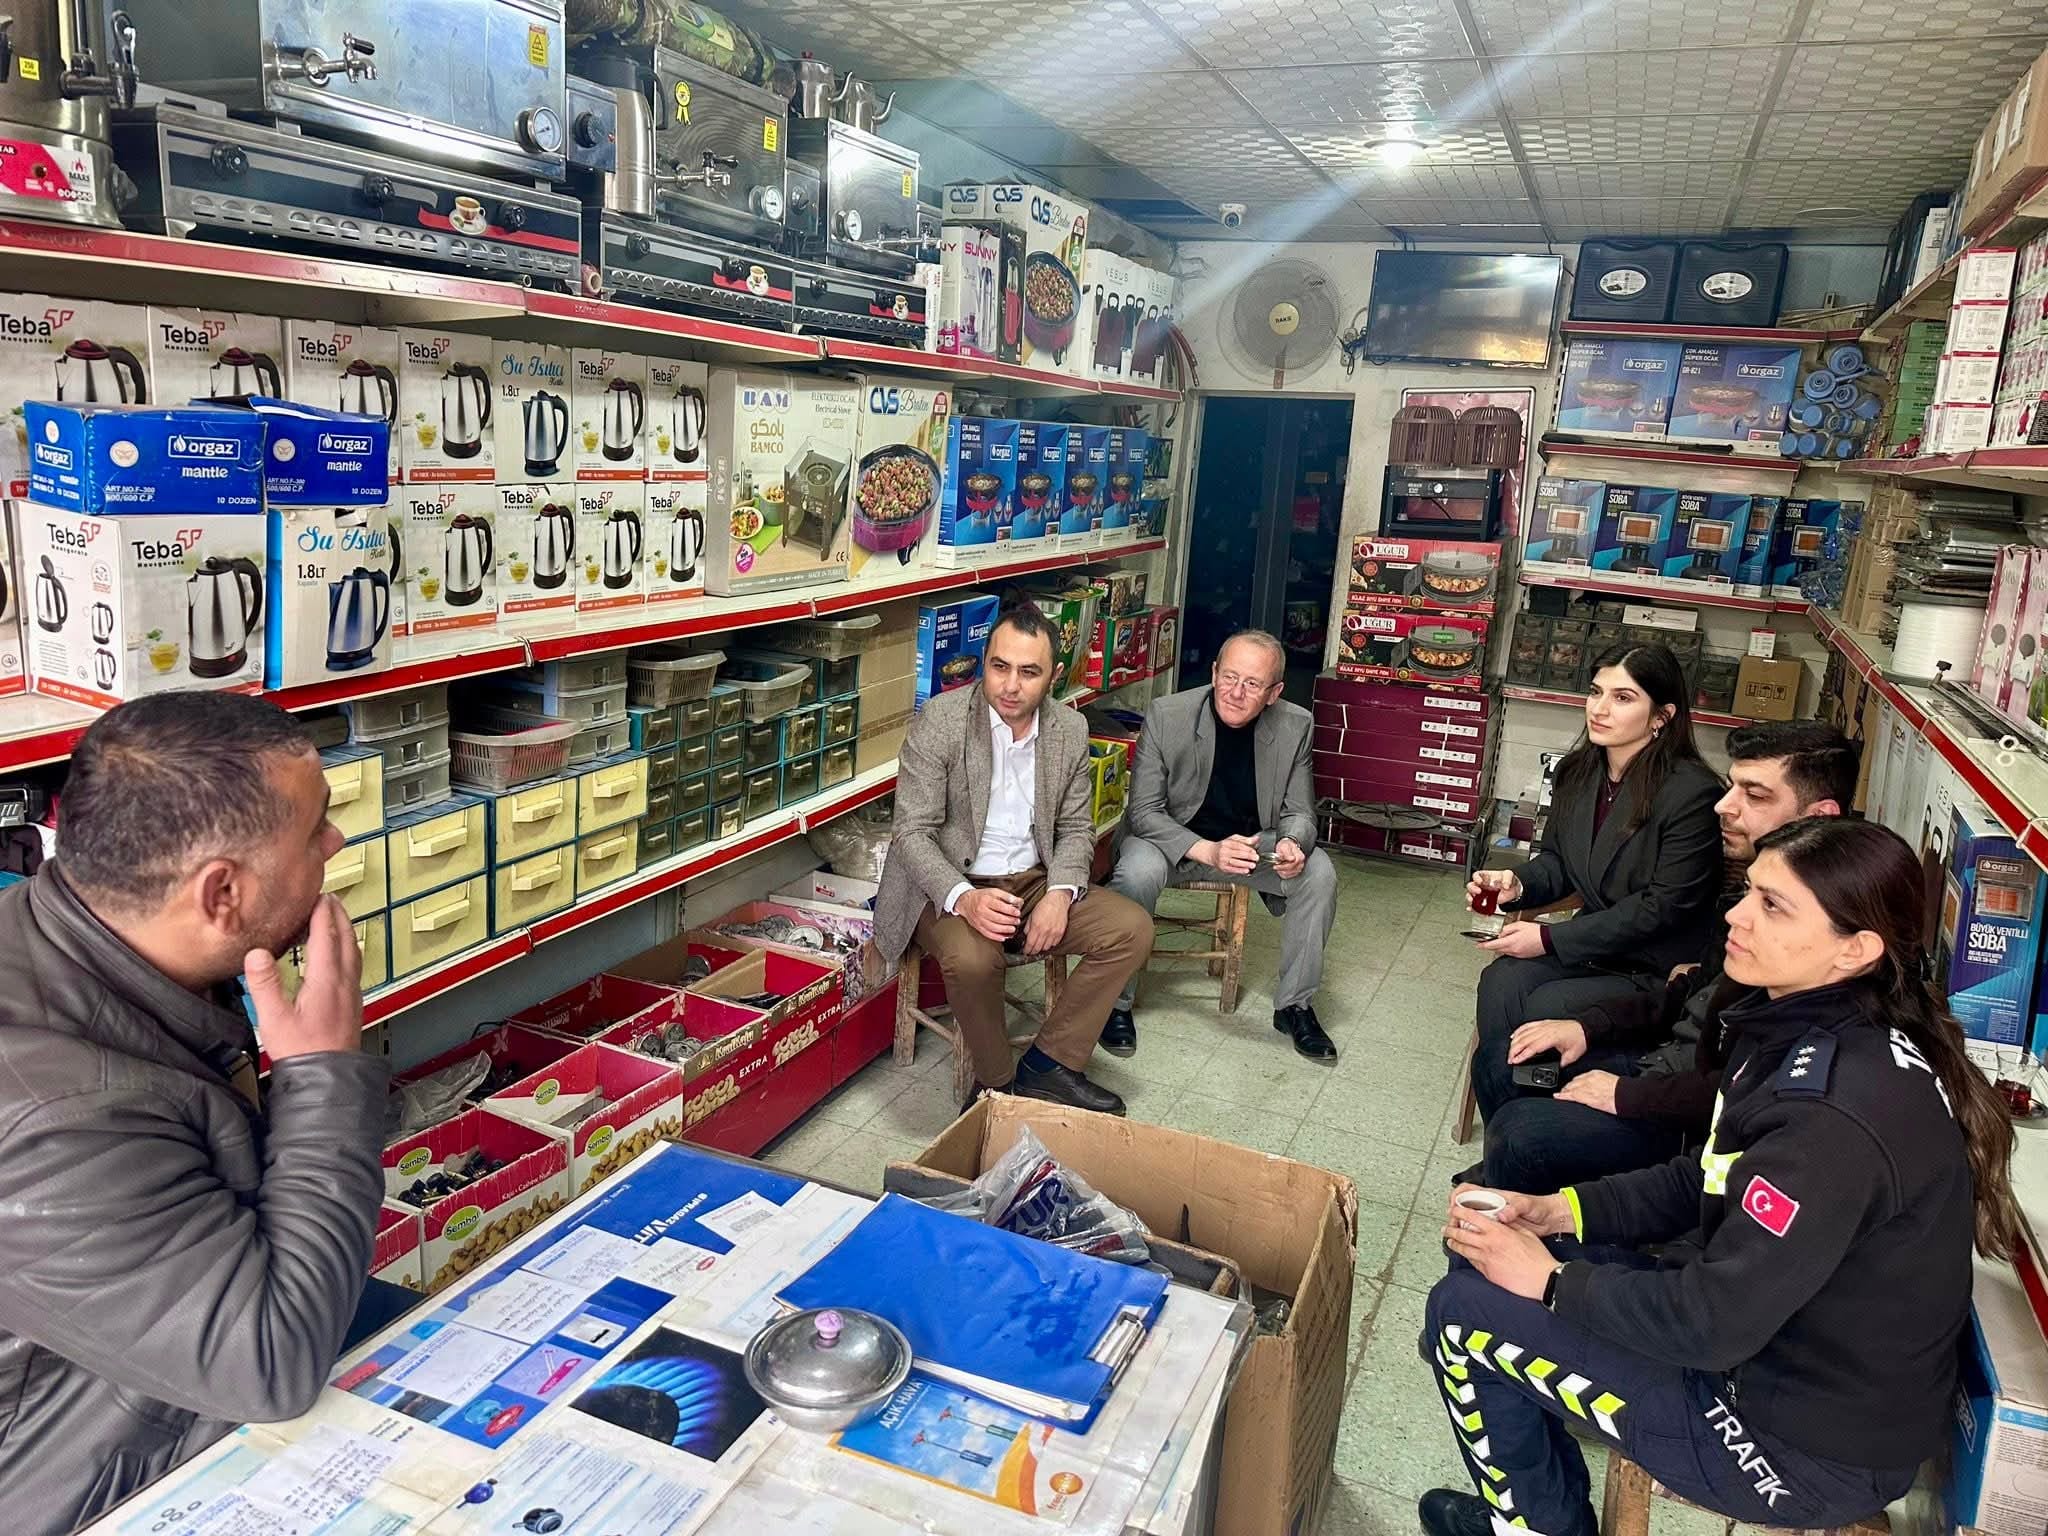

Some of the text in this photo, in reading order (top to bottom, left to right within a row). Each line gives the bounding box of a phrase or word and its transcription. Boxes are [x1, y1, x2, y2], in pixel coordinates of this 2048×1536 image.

[949, 188, 978, 202] CVS
[992, 188, 1023, 202] CVS
[1031, 195, 1051, 225] CVS
[964, 242, 997, 260] SUNNY
[0, 314, 51, 337] Teba
[160, 324, 209, 345] Teba
[298, 336, 338, 356] Teba
[405, 341, 439, 359] Teba
[578, 360, 603, 376] Teba
[1634, 360, 1663, 371] orgaz
[1749, 367, 1779, 378] orgaz
[651, 367, 672, 382] Teba
[870, 387, 900, 414] CVS
[188, 440, 234, 456] orgaz
[333, 439, 369, 452] orgaz
[750, 441, 784, 454] BAMCO
[44, 449, 69, 465] orgaz
[182, 466, 229, 479] mantle
[327, 460, 363, 472] mantle
[360, 488, 383, 496] DOZEN
[502, 490, 533, 504] Teba
[1539, 487, 1558, 497] SOBA
[1608, 494, 1628, 504] SOBA
[228, 496, 257, 505] DOZEN
[409, 500, 444, 515] Teba
[580, 497, 603, 510] Teba
[650, 496, 672, 508] Teba
[1680, 500, 1700, 511] SOBA
[1785, 507, 1802, 519] SOBA
[46, 523, 86, 548] Teba
[297, 526, 335, 552] Su
[131, 541, 183, 560] Teba
[1376, 545, 1406, 555] UĞUR
[1364, 617, 1394, 629] UĞUR
[1991, 863, 2020, 873] orgaz
[1970, 922, 2029, 939] BÜYÜK VENTİLLİ
[1968, 931, 2007, 952] SOBA
[817, 1003, 842, 1025] EXTRA
[739, 1055, 768, 1078] EXTRA
[586, 1133, 613, 1152] Sembol
[399, 1152, 429, 1173] Sembol
[518, 1177, 539, 1192] Cashew
[445, 1212, 481, 1236] Sembol
[386, 1250, 402, 1267] Nuts
[879, 1379, 925, 1430] AÇIK HAVA
